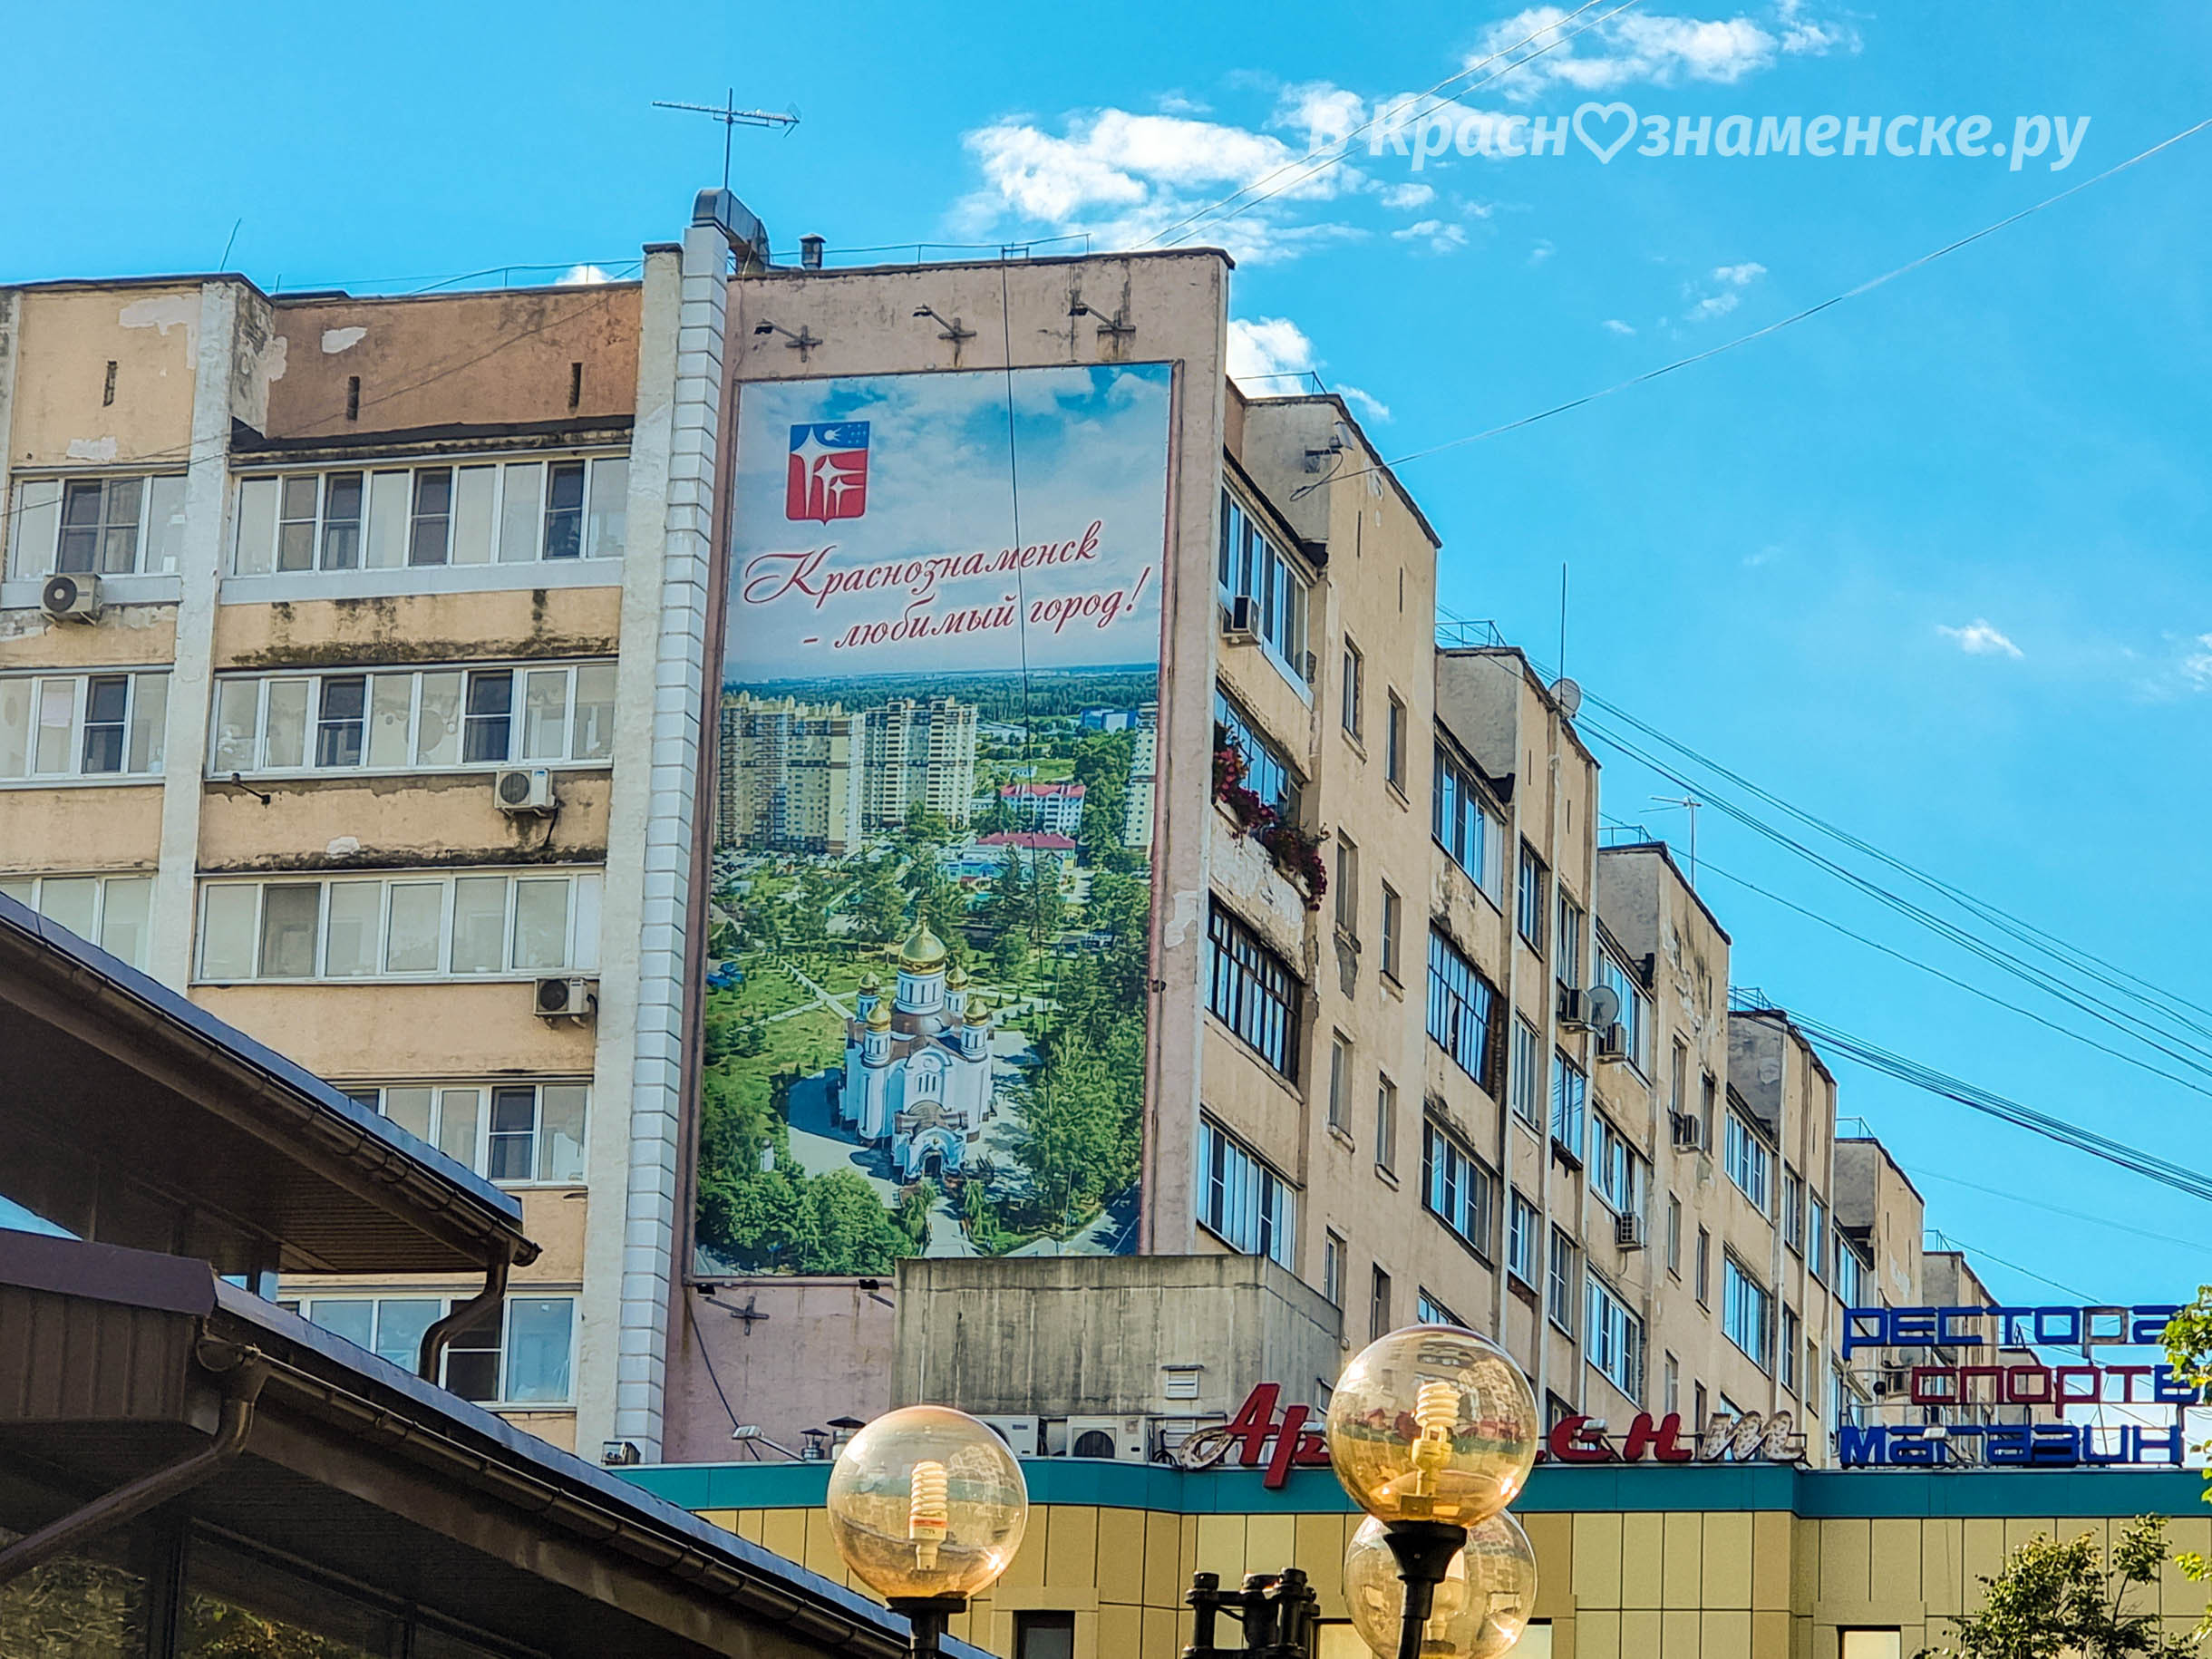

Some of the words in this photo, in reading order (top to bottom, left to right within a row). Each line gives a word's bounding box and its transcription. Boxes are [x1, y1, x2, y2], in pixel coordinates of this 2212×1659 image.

[743, 520, 1102, 608] Краснознаменск
[833, 592, 1016, 649] любимый
[1030, 567, 1151, 635] город!
[1842, 1305, 2196, 1361] рестора
